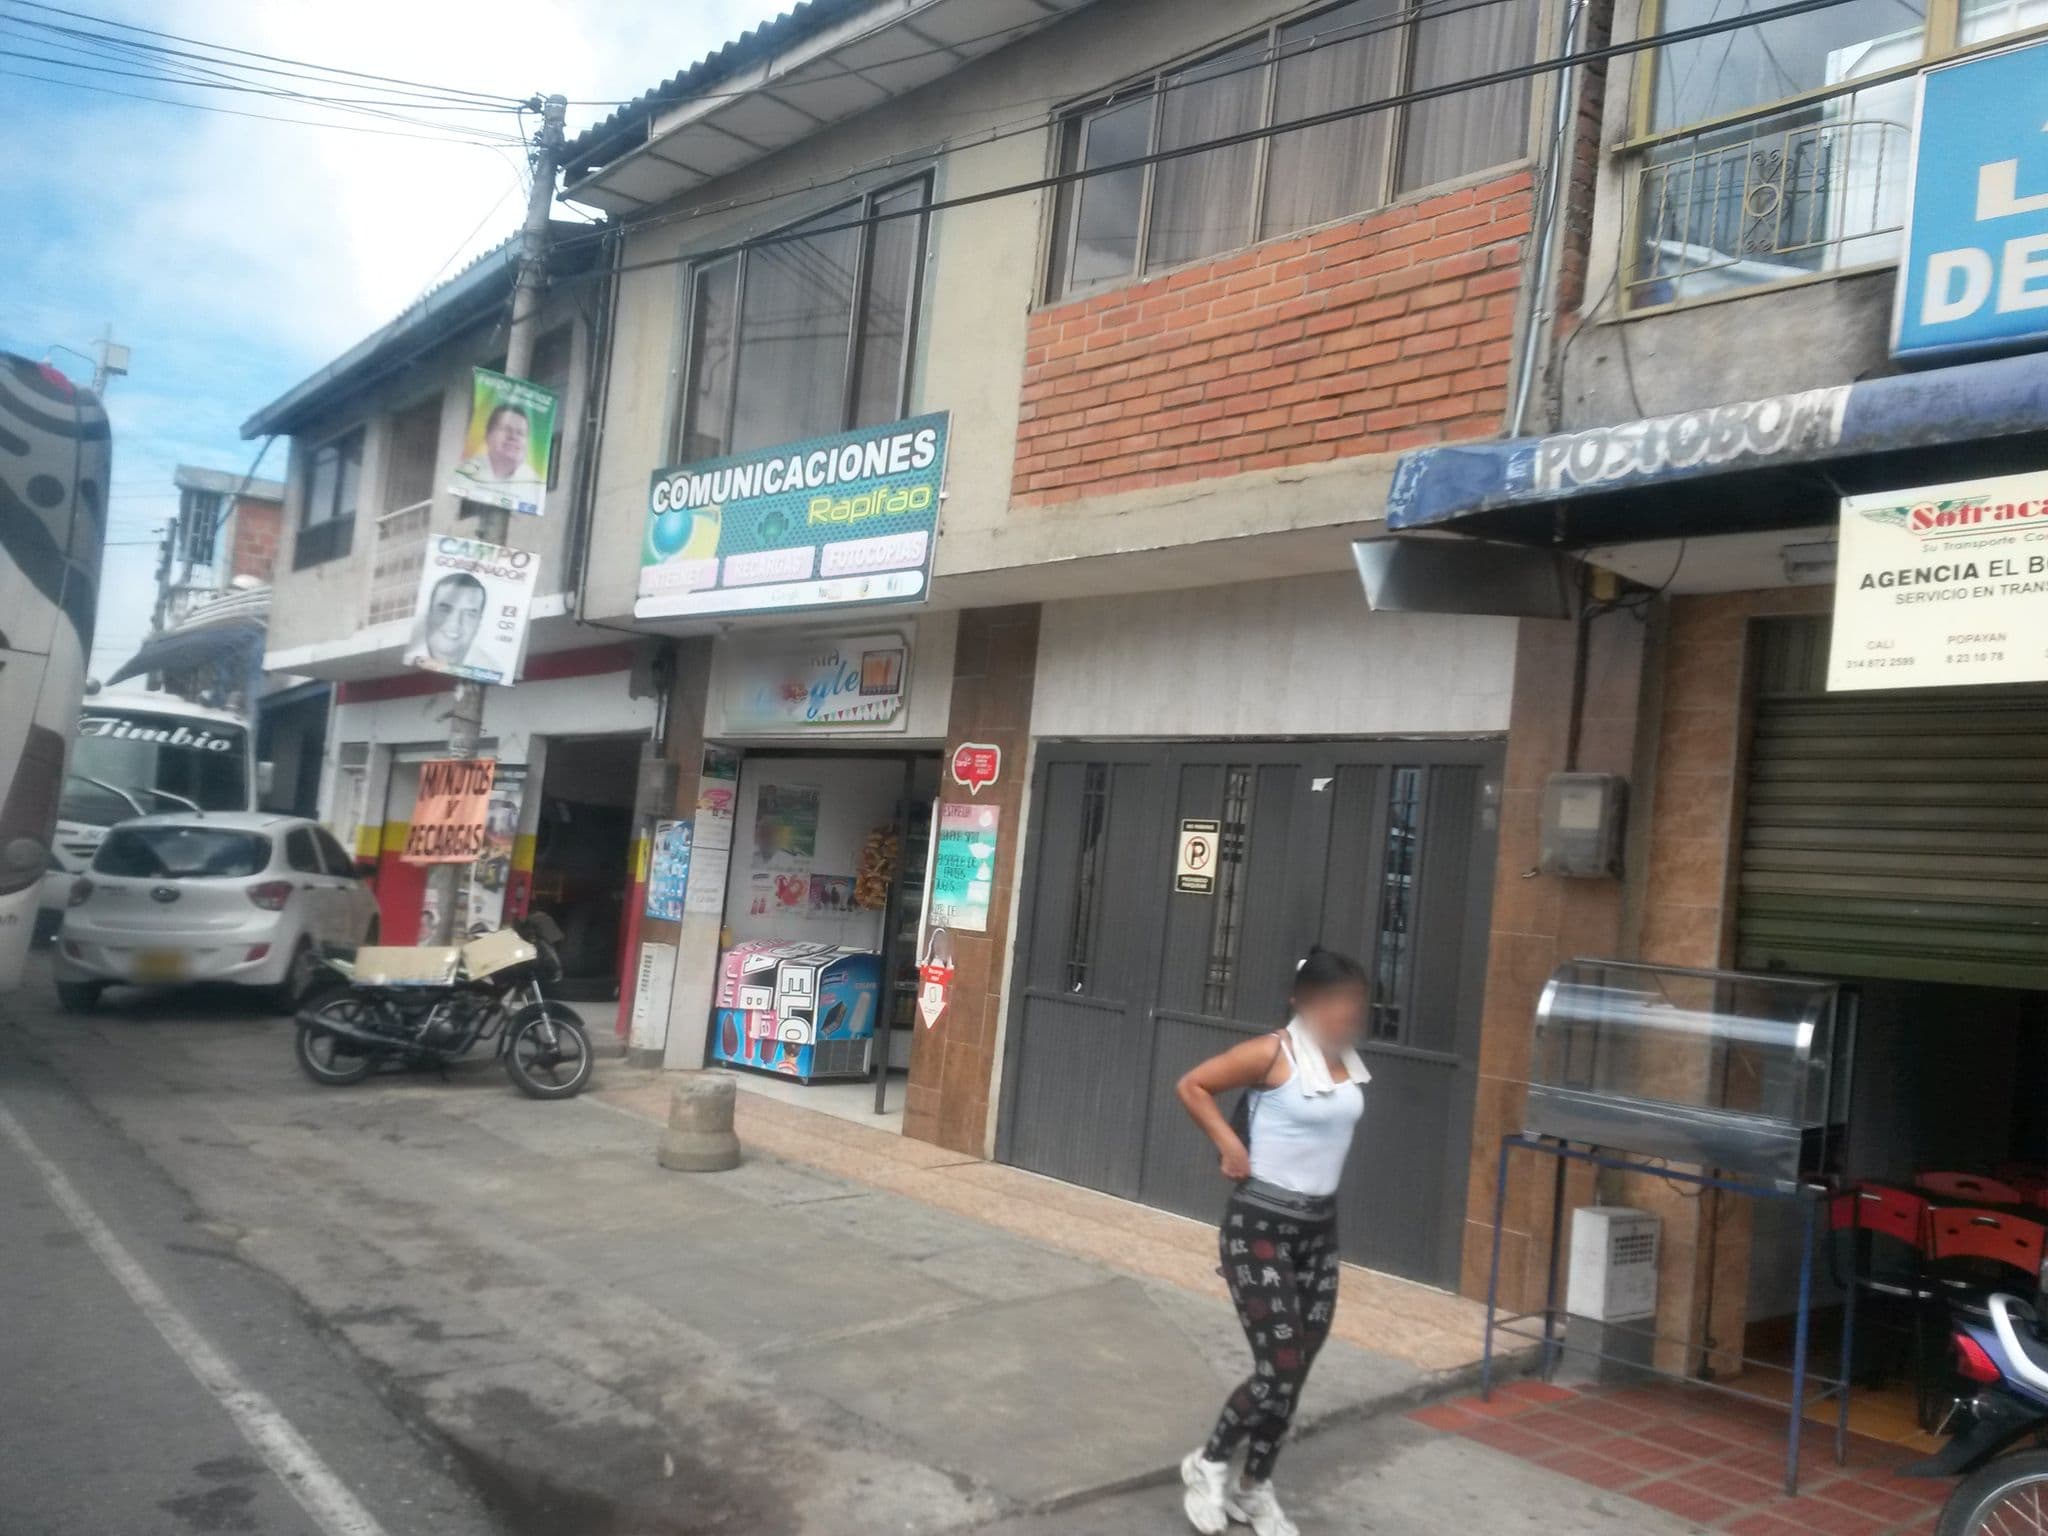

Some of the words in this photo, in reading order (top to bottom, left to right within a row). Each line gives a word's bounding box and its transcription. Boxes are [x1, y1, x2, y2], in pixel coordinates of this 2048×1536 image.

[651, 428, 938, 514] COMUNICACIONES
[829, 539, 922, 572] FOTOCOPIAS
[1943, 536, 2017, 551] Transporte
[1859, 563, 1980, 590] AGENCIA
[1989, 559, 2019, 577] EL
[2029, 555, 2048, 574] B
[1896, 588, 1968, 605] SERVICIO
[1973, 586, 1994, 598] EN
[1866, 639, 1895, 650] CALI
[1947, 632, 2007, 645] POPAYAN
[77, 713, 232, 752] Timbio
[417, 763, 492, 801] MINUTOS
[446, 799, 461, 820] Y
[406, 823, 484, 857] RECARGAS
